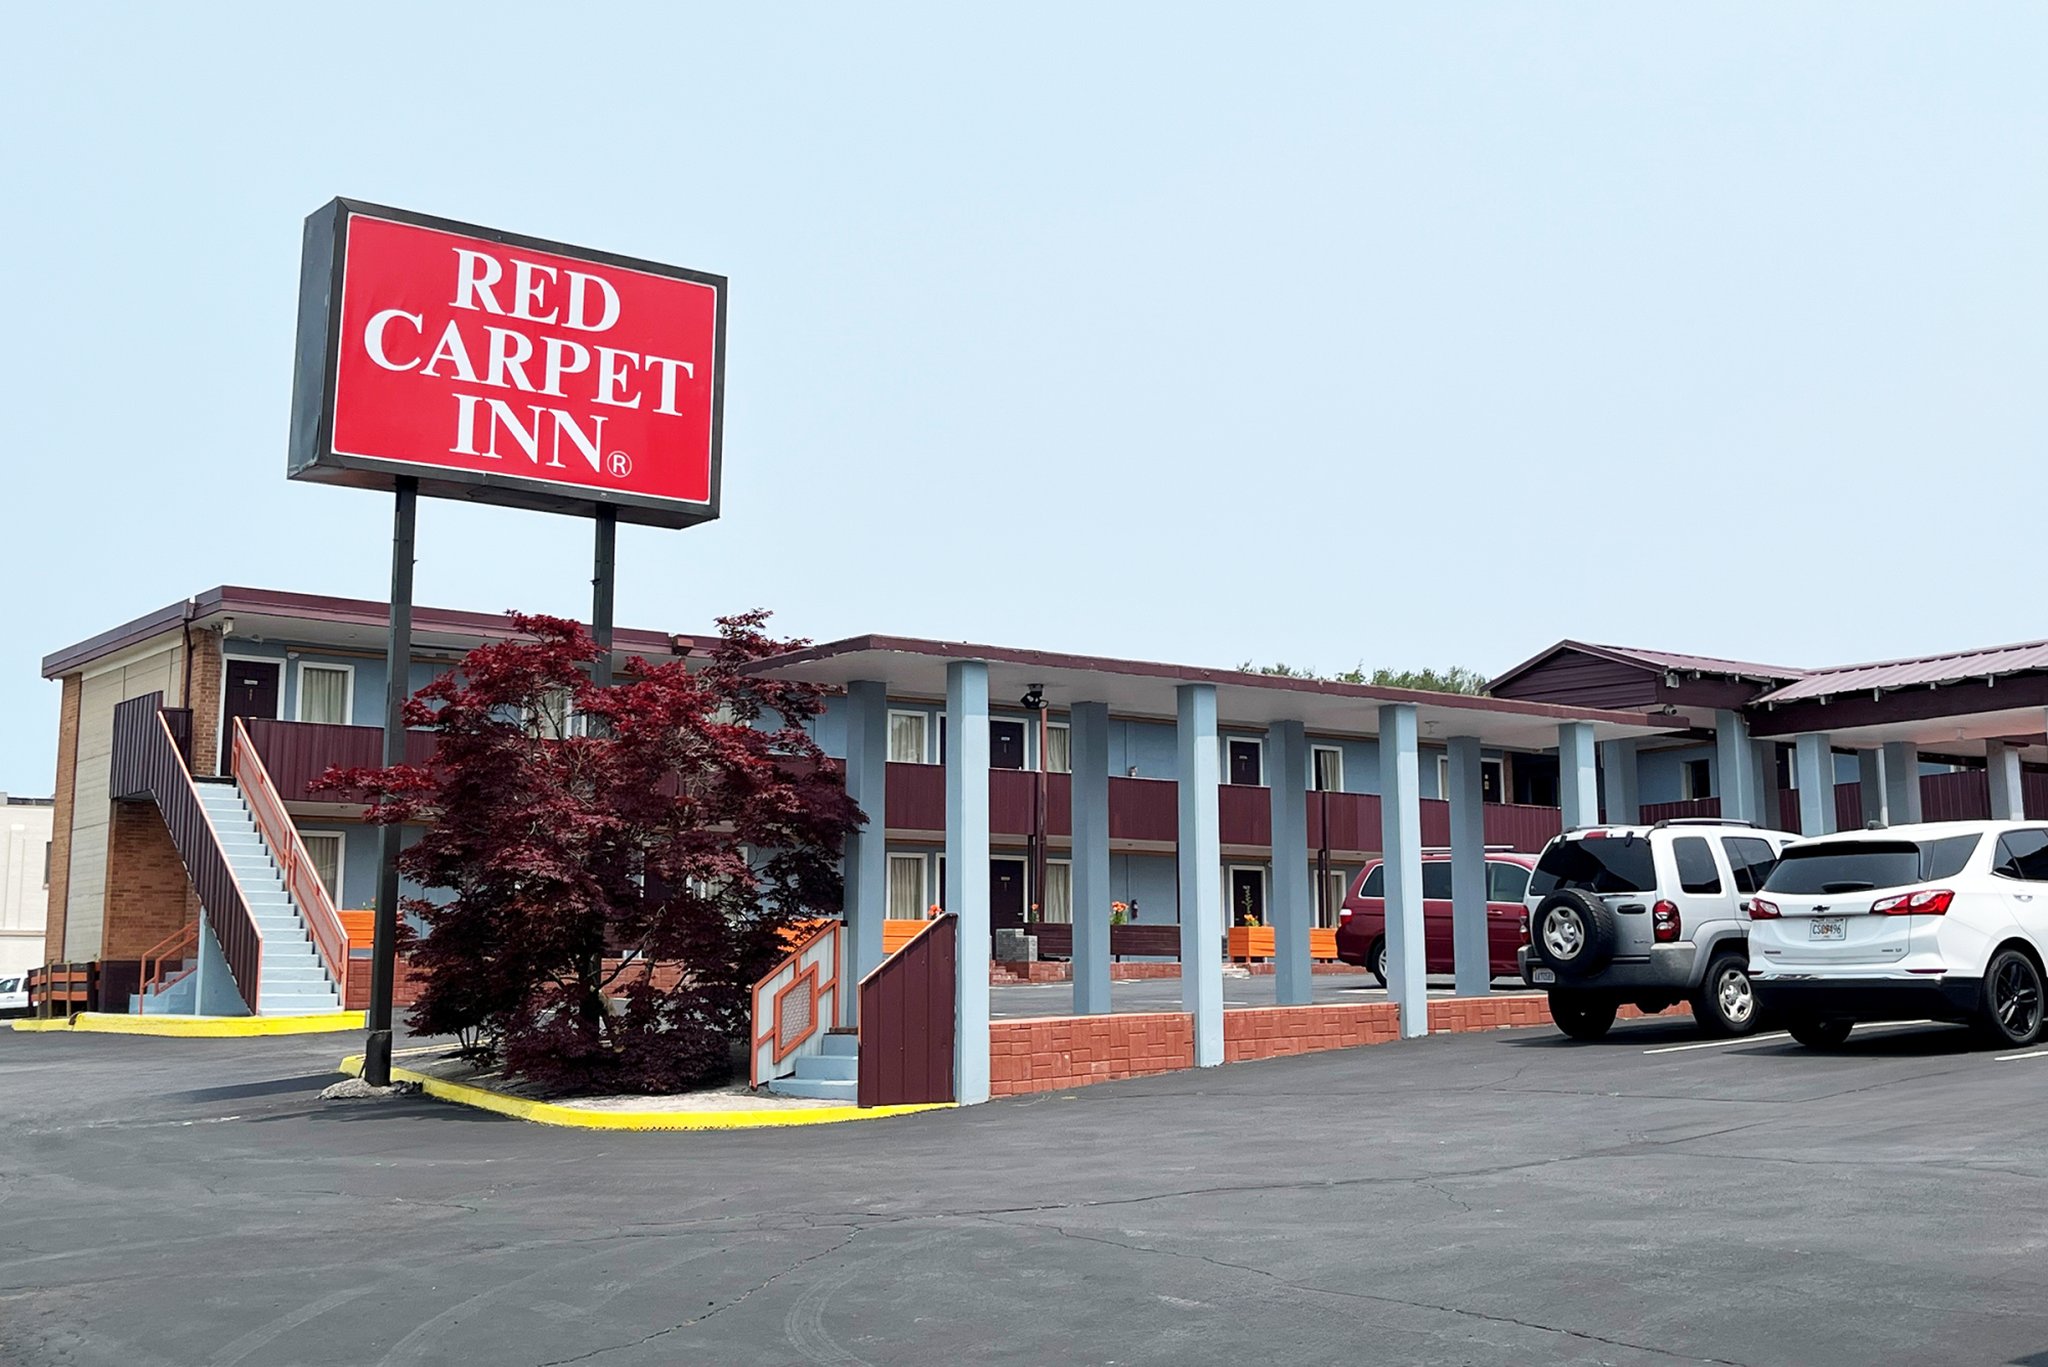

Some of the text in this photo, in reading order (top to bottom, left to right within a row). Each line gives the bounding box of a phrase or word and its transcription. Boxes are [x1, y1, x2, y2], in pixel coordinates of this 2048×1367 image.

[449, 248, 621, 332] RED
[364, 309, 694, 416] CARPET
[449, 393, 608, 473] INN
